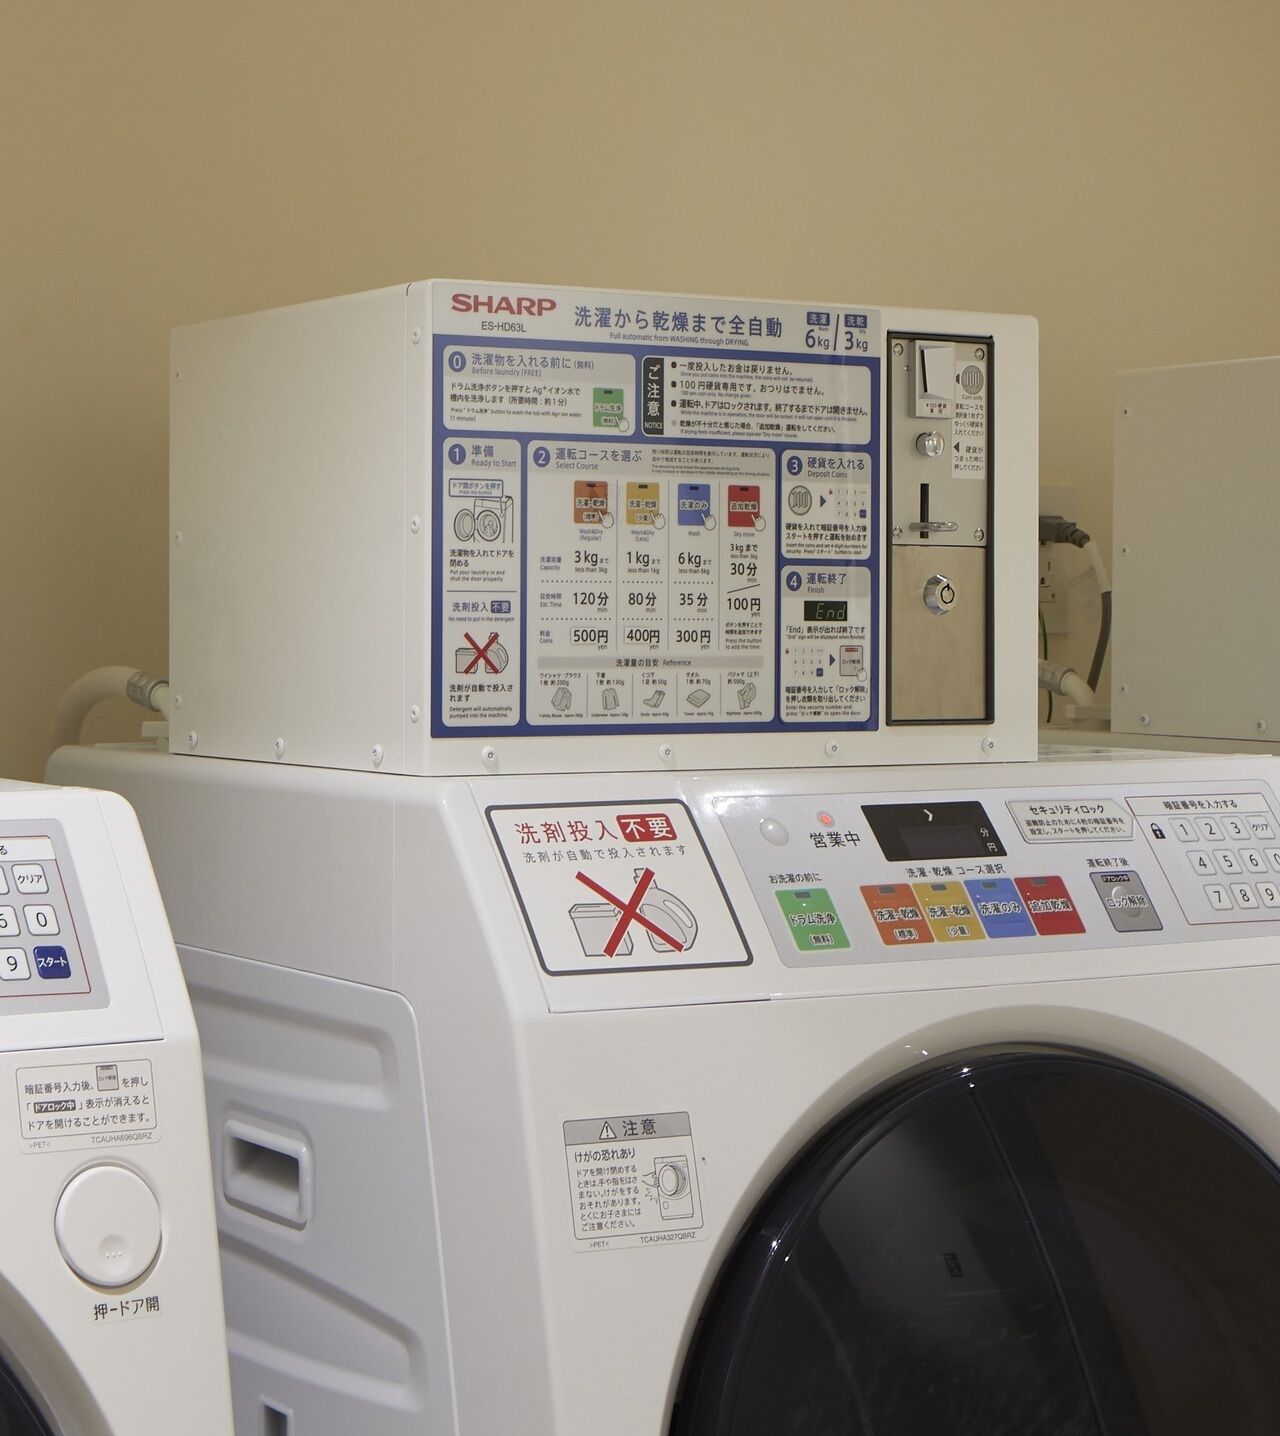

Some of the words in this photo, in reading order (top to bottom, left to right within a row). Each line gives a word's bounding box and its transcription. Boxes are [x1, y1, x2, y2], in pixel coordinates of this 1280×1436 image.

[451, 293, 556, 317] SHARP
[481, 321, 526, 333] ES-HD63L
[574, 306, 782, 339] 洗濯から乾燥まで全自動
[471, 353, 570, 369] 洗濯物を入れる前に
[471, 445, 495, 458] 準備
[555, 447, 642, 463] 運転コースを選ぶ
[807, 457, 865, 471] 硬貨を入れる
[807, 573, 847, 586] 運転終了
[574, 628, 609, 644] 500円
[677, 629, 711, 644] 300円
[1030, 804, 1104, 814] セキュリティロック
[515, 820, 619, 845] 洗剤投入
[620, 817, 673, 839] 不要
[810, 832, 861, 848] 営業中
[523, 845, 686, 863] 洗剤が自動で投入されます
[17, 874, 43, 885] クリア
[979, 902, 1020, 914] 洗濯のみ
[36, 912, 47, 928] 0
[7, 956, 18, 972] 9
[37, 956, 67, 969] スタート
[623, 1119, 656, 1136] 注意
[575, 1148, 635, 1163] けがの恐れあり
